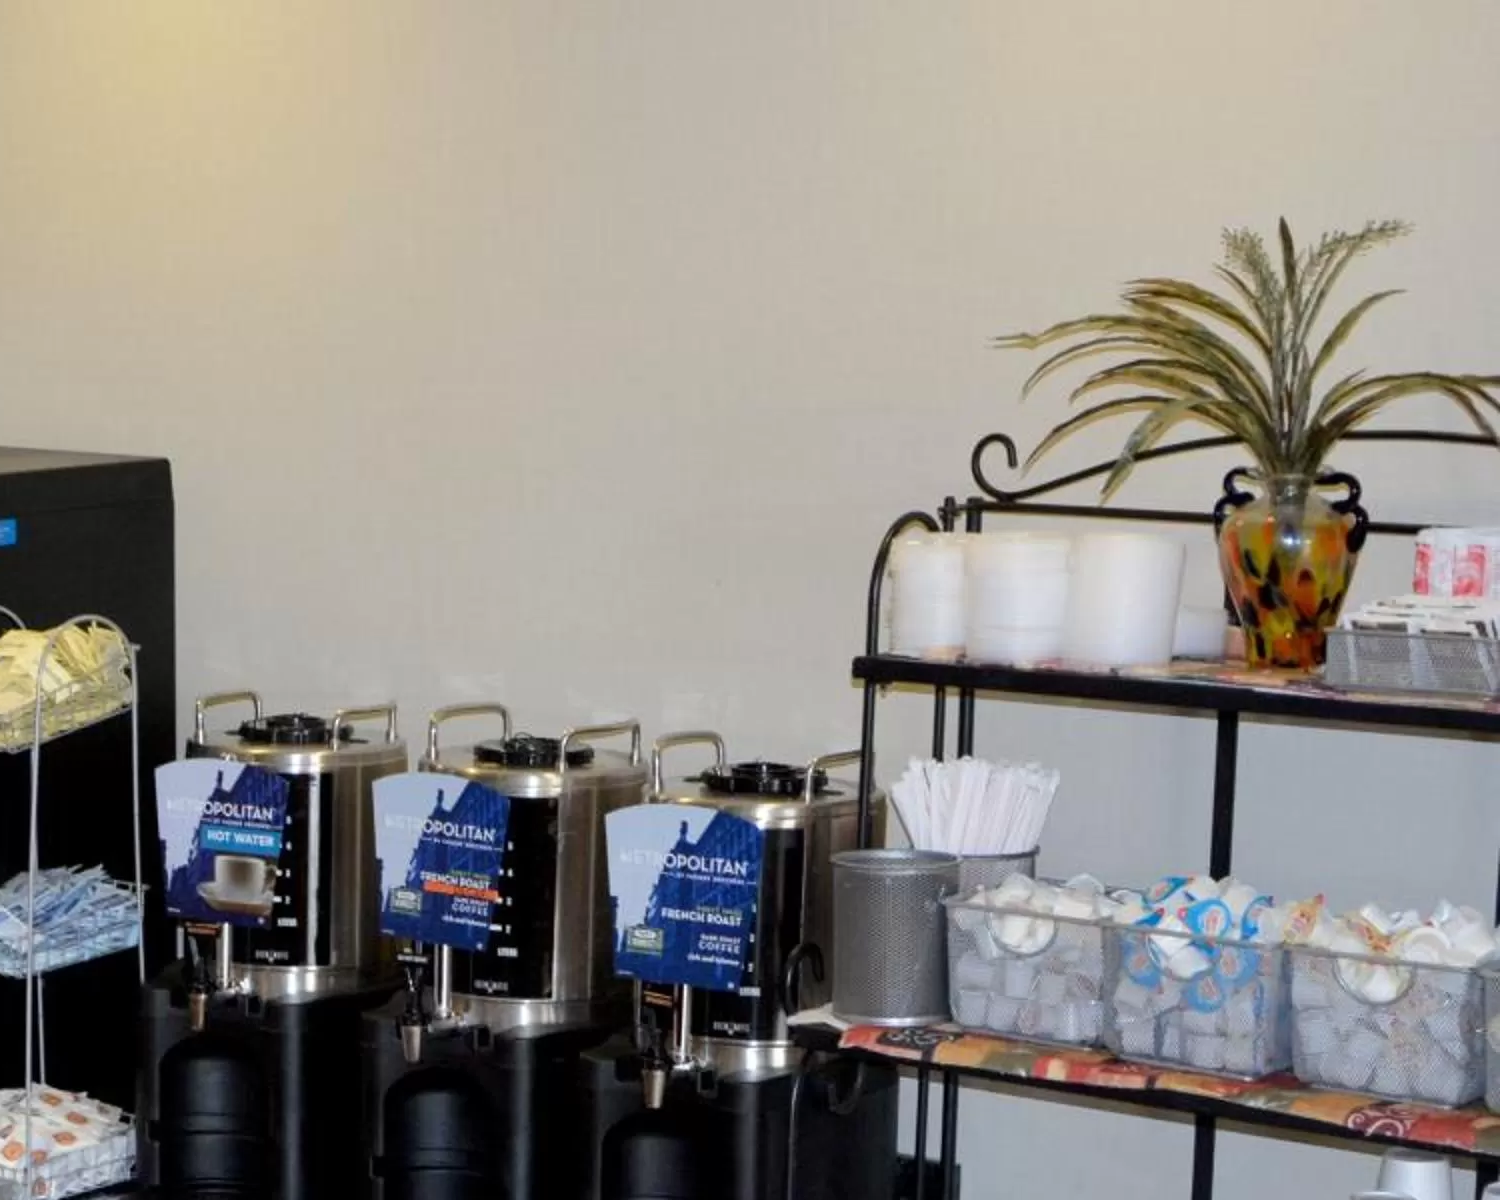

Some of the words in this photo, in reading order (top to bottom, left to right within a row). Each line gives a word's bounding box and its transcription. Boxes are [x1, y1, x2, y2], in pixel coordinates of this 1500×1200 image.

[206, 829, 232, 842] HOT
[233, 832, 274, 847] WATER
[619, 851, 748, 877] METROPOLITAN
[420, 871, 459, 885] FRENCH
[460, 875, 491, 890] ROAST
[451, 903, 489, 916] COFFEE
[660, 907, 705, 924] FRENCH
[706, 913, 742, 927] ROAST
[698, 940, 740, 955] COFFEE
